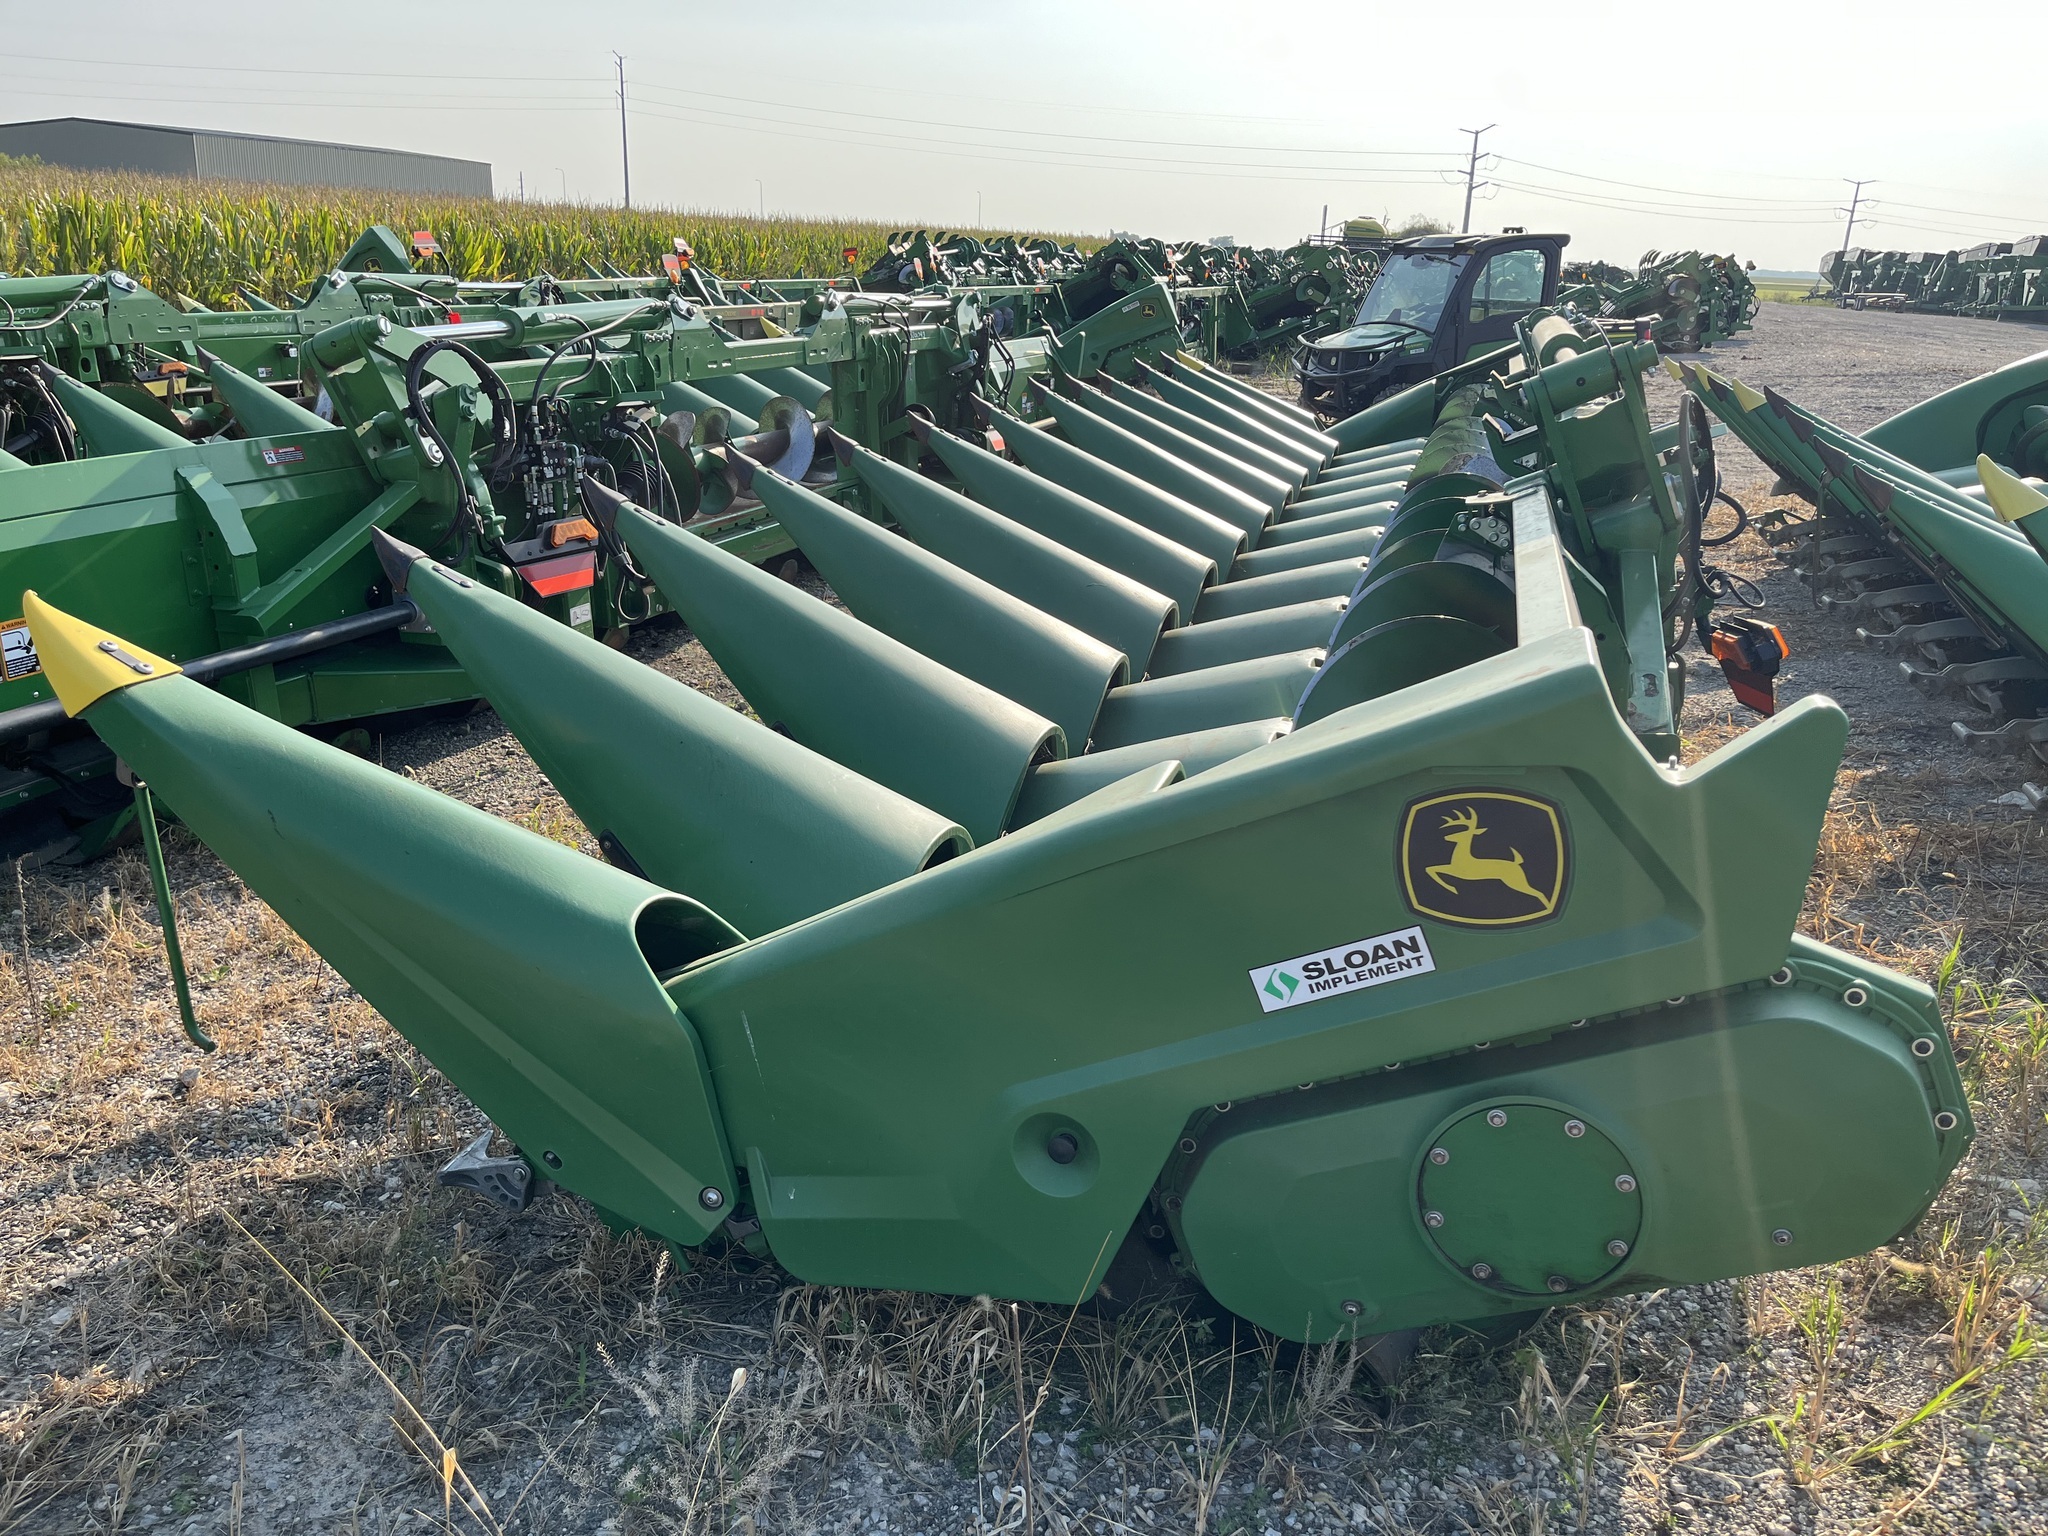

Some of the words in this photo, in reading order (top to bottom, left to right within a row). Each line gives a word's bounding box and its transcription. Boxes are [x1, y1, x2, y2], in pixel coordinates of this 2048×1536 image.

[6, 620, 27, 628] WARNIN
[1302, 935, 1421, 980] SLOAN
[1308, 955, 1424, 994] IMPLEMENT
